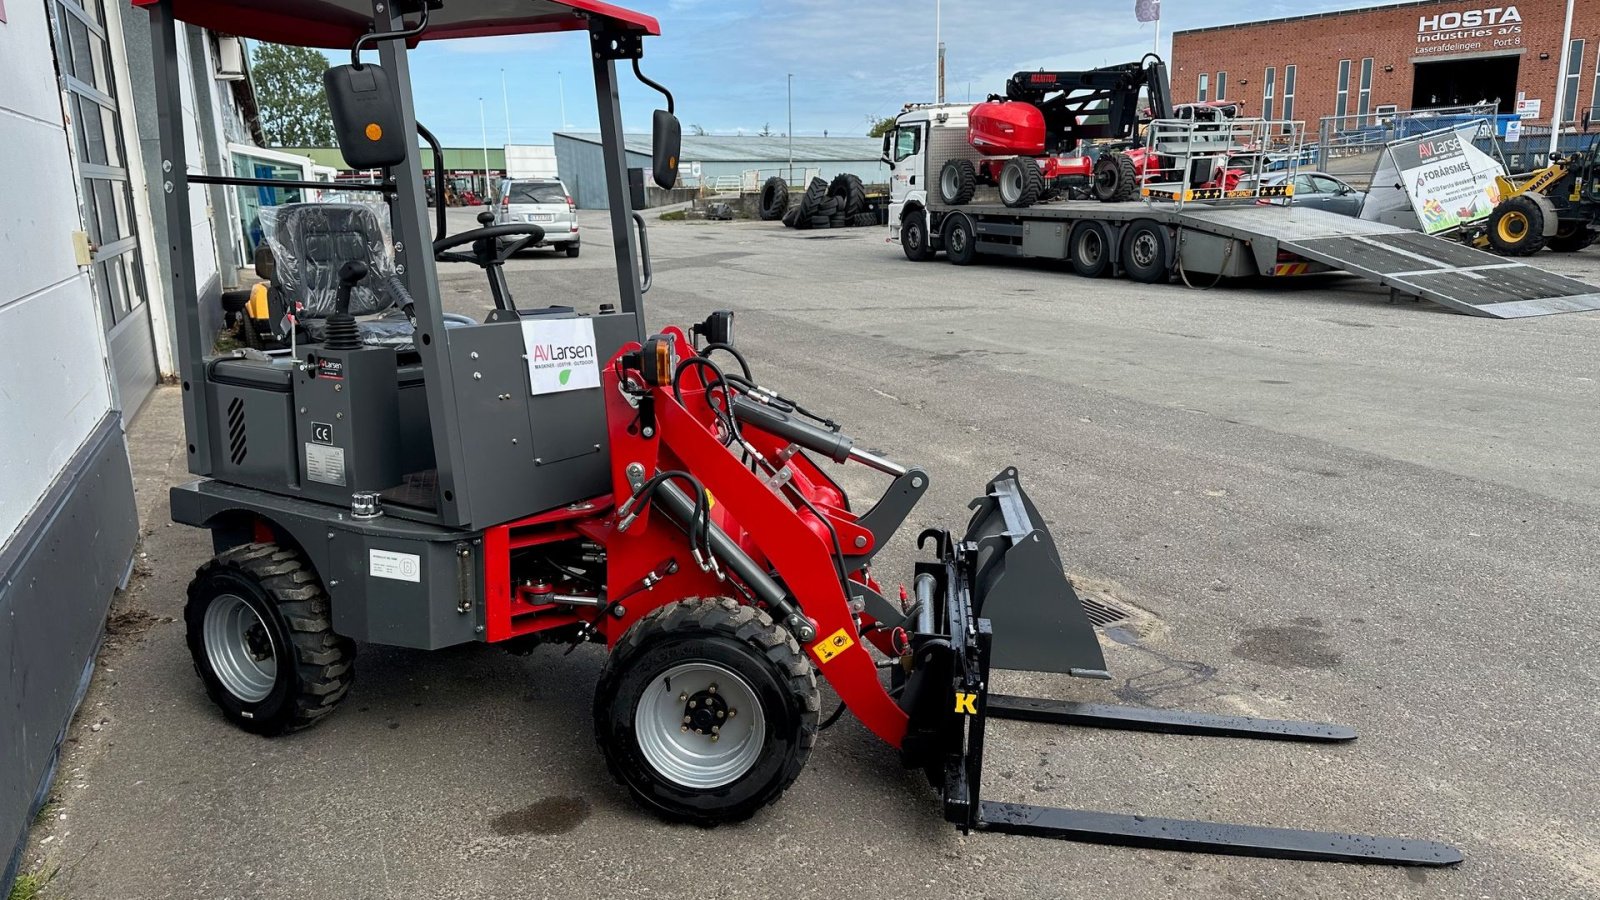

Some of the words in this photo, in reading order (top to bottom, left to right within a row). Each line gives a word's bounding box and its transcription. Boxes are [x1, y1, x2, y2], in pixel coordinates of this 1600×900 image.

[1418, 6, 1522, 32] HOSTA
[1417, 29, 1493, 43] industries
[1498, 25, 1522, 35] a/s
[1415, 42, 1481, 54] Laserafdelingen
[1493, 38, 1512, 47] Port
[1514, 37, 1520, 45] 8
[534, 344, 593, 362] AVLarsen
[316, 427, 329, 441] CE
[954, 692, 977, 714] K
